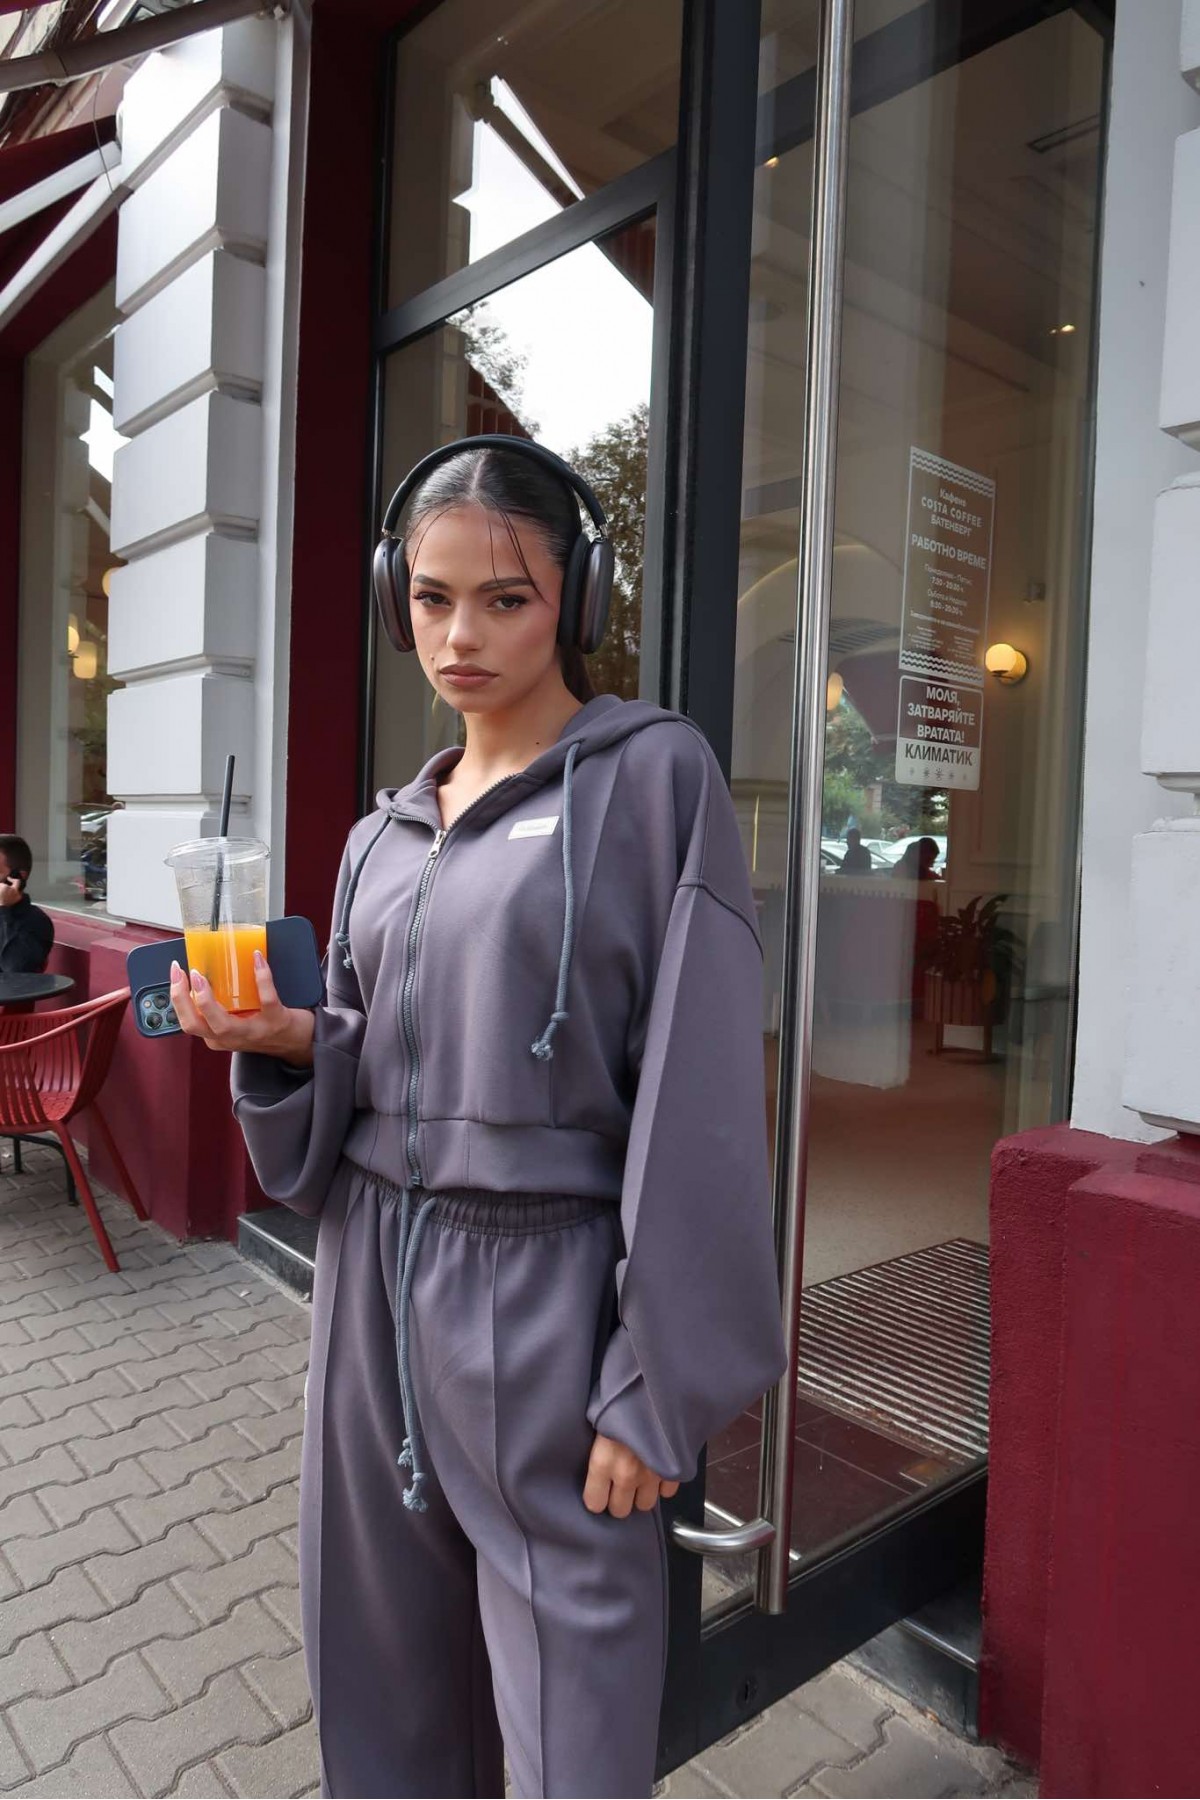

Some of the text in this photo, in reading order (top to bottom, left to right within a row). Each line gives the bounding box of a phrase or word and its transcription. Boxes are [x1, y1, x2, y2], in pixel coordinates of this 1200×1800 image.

[921, 496, 982, 528] COSTA COFFEE
[930, 514, 972, 536] БАТЕНБЕРГ
[911, 533, 987, 570] РАБОТНО ВРЕМЕ
[926, 686, 960, 707] МОЛЯ,
[907, 702, 975, 726] ЗАТВАРЯЙТЕ
[917, 724, 965, 743] ВРАТАТА!
[905, 743, 973, 766] КЛИМАТИК
